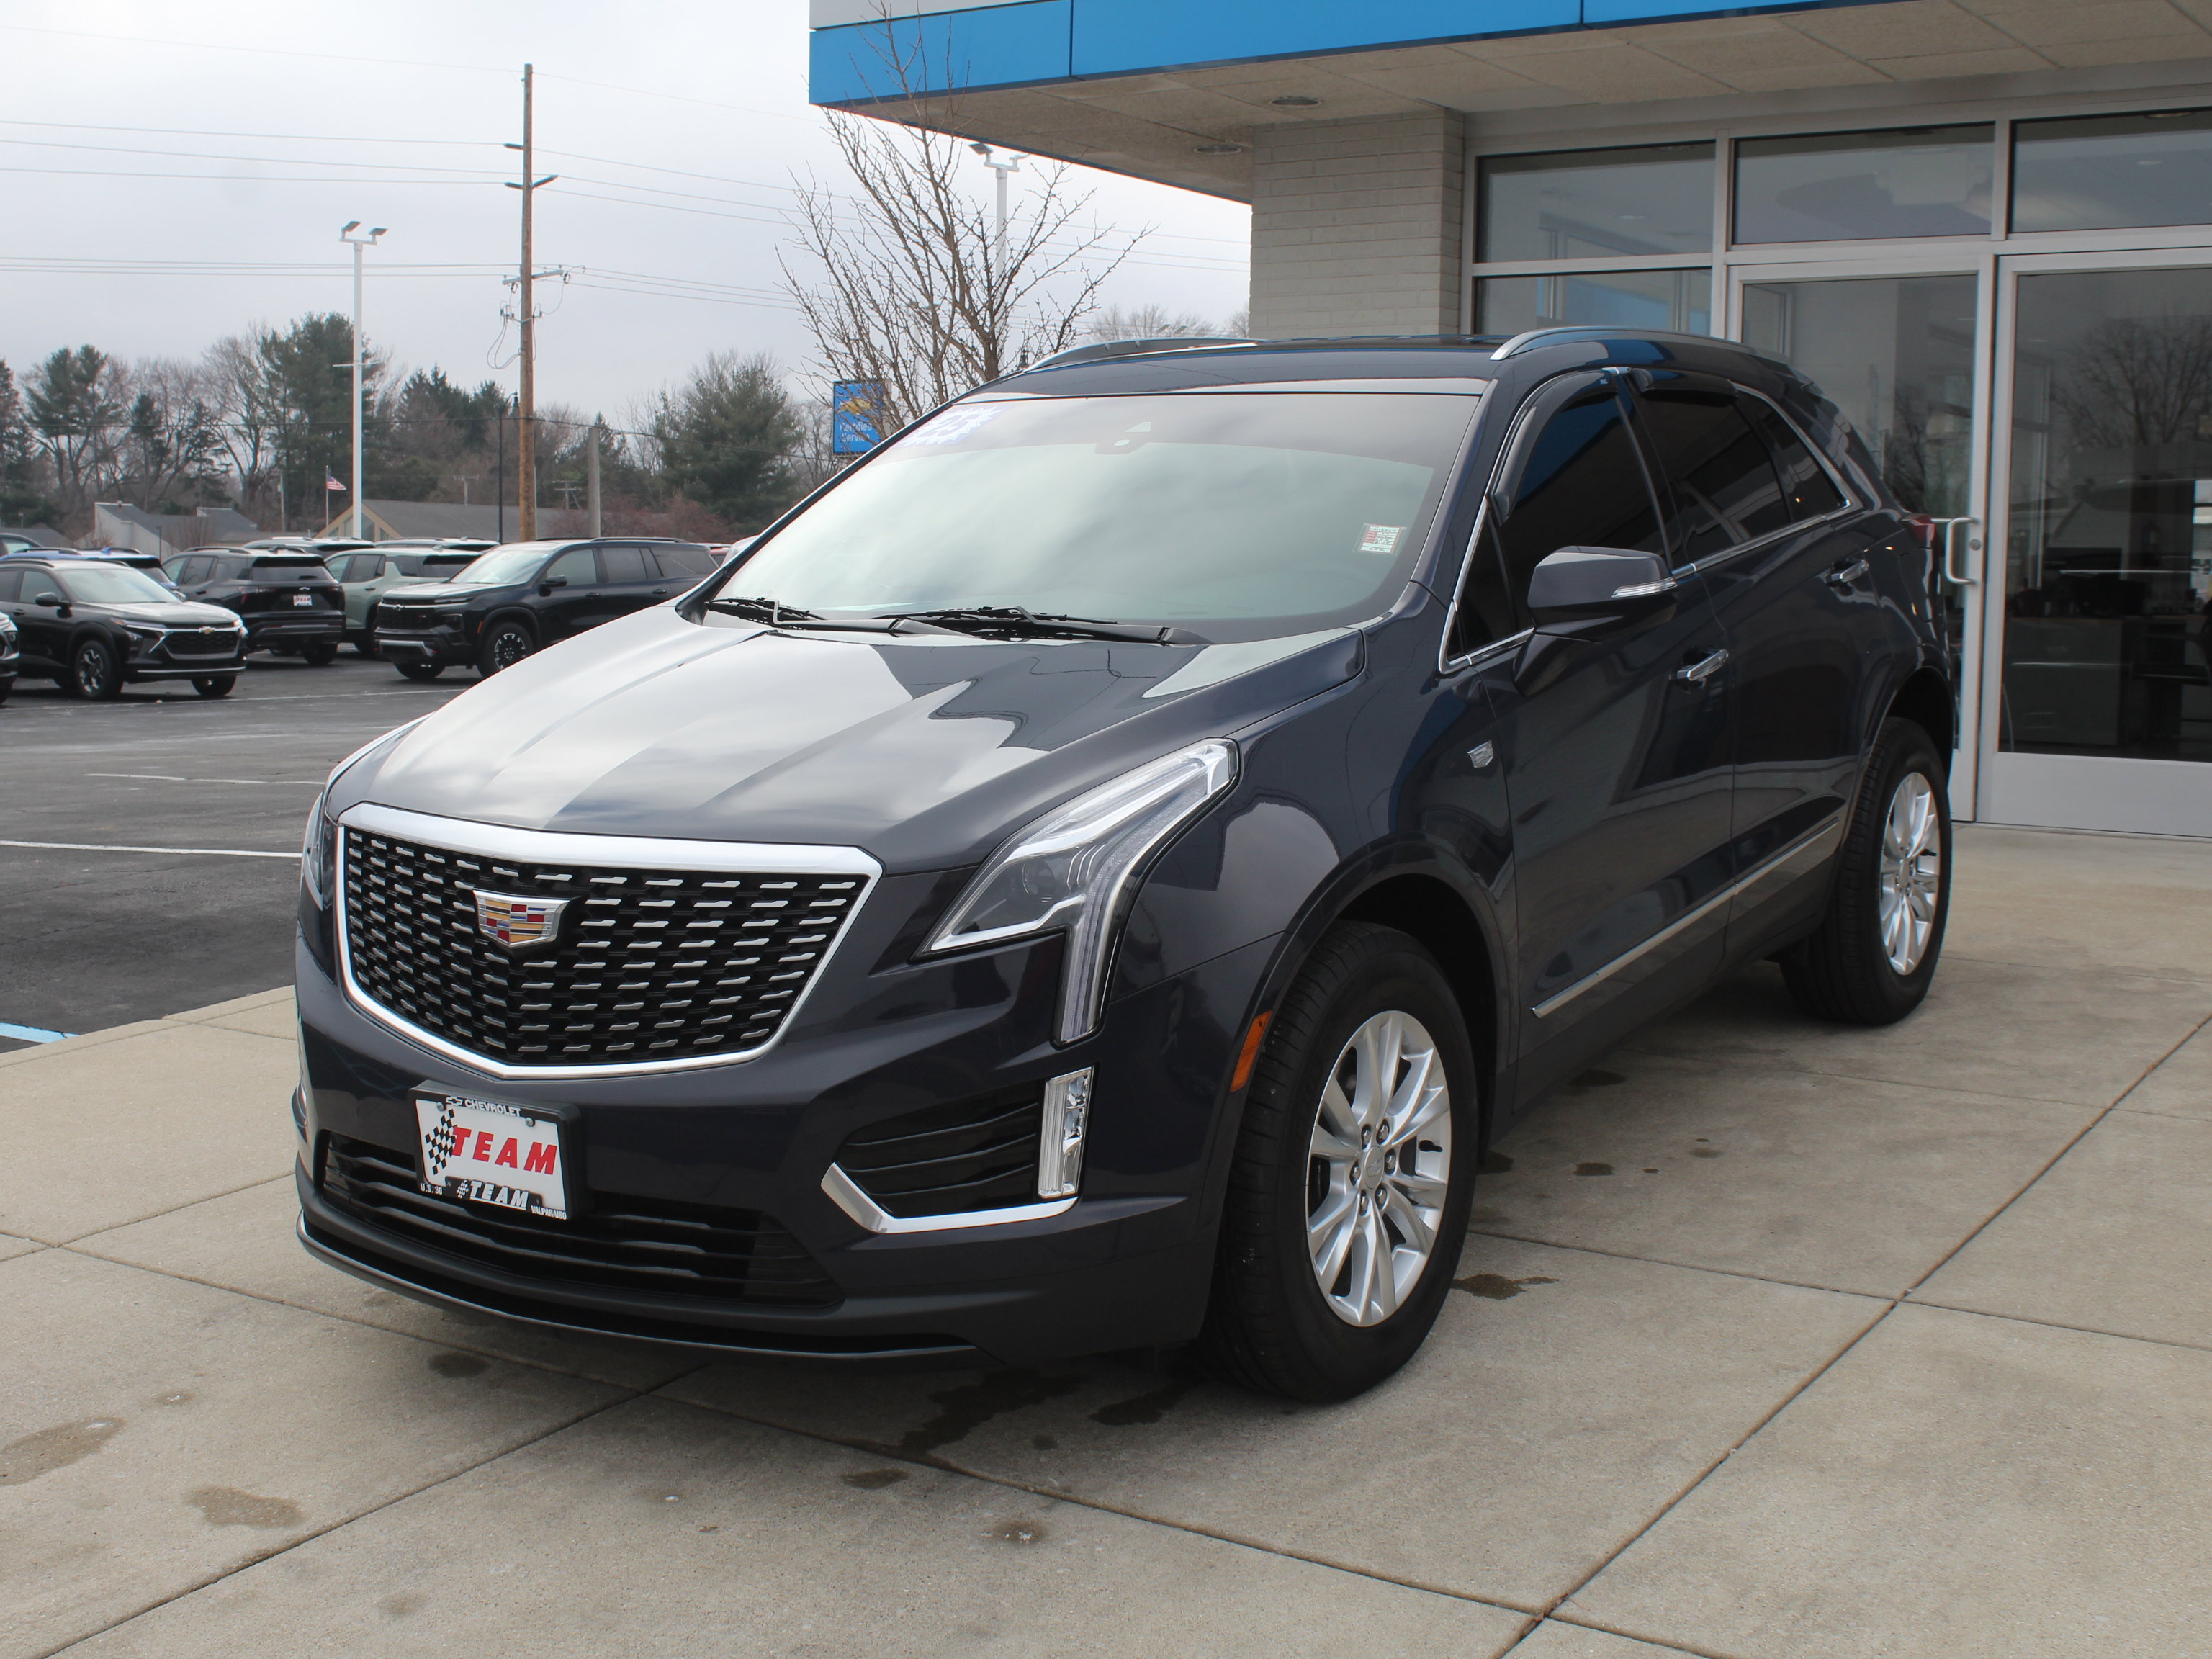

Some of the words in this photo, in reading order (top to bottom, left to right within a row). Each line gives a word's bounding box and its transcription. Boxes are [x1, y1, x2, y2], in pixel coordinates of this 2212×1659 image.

[464, 1099, 521, 1117] CHEVROLET
[451, 1126, 557, 1175] TEAM
[420, 1183, 433, 1194] U.S.
[434, 1186, 443, 1195] 30
[469, 1180, 529, 1208] TEAM
[531, 1205, 567, 1220] VALPARAISO
